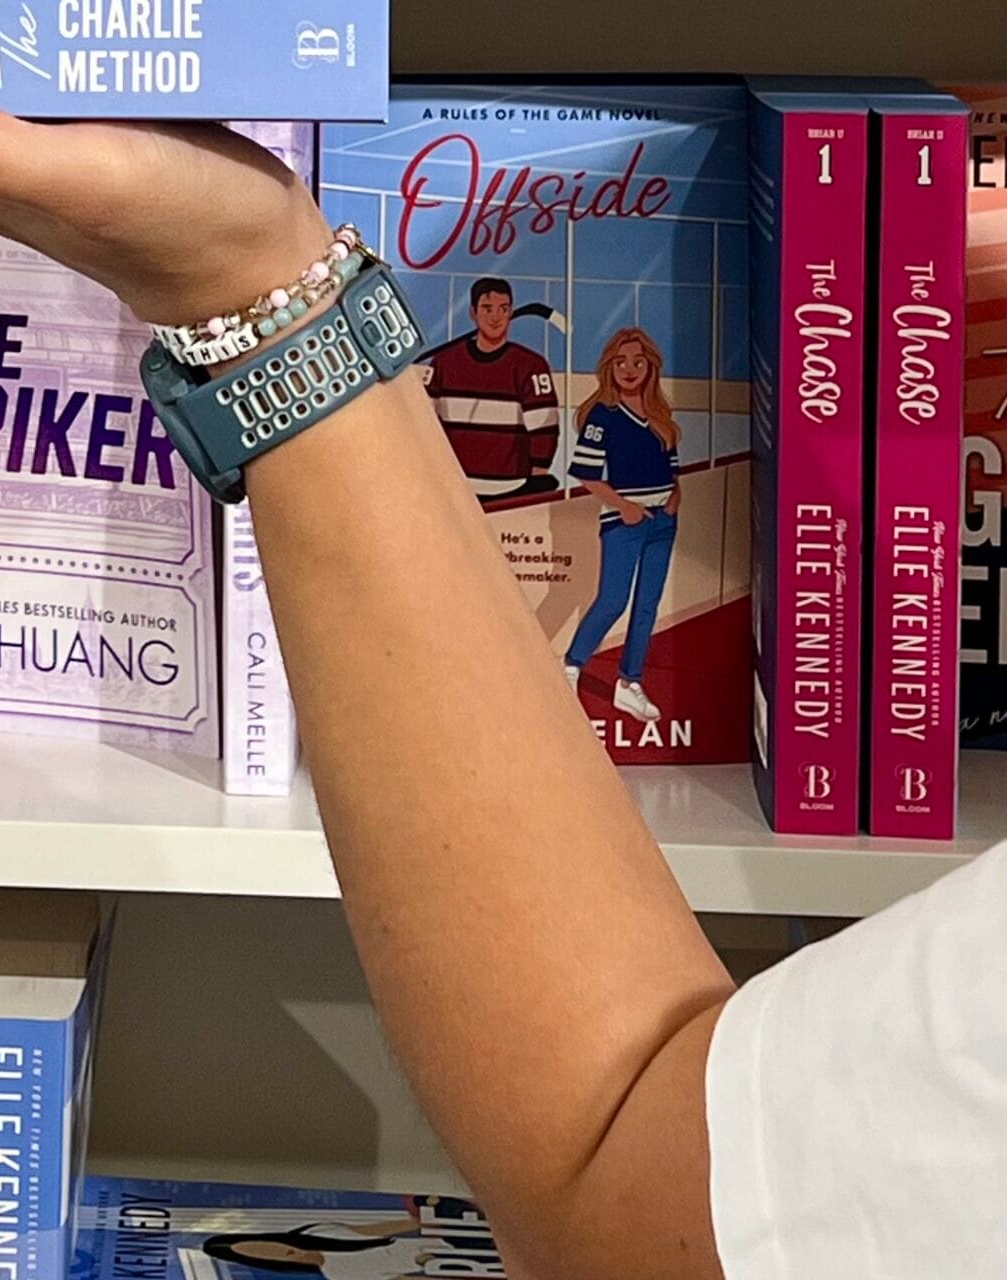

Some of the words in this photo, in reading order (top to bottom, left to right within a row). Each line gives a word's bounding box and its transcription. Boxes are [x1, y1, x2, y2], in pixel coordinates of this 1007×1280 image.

[58, 49, 201, 94] METHOD
[422, 107, 433, 119] A
[440, 107, 488, 120] RULES
[494, 107, 517, 120] OF
[522, 108, 551, 120] THE
[556, 108, 602, 121] GAME
[609, 108, 661, 121] NOVEL
[398, 133, 670, 270] Offside
[806, 260, 837, 300] The
[904, 261, 935, 301] The
[186, 335, 251, 363] THIS
[794, 303, 853, 423] Chase
[893, 304, 951, 425] Chase
[531, 373, 554, 395] 19
[584, 423, 603, 443] 86
[501, 532, 529, 545] He's
[535, 535, 543, 545] a
[796, 504, 832, 576] ELLE
[894, 505, 930, 578] ELLE
[23, 602, 115, 625] BESTSELLING
[120, 613, 177, 632] AUTHOR
[247, 632, 266, 689] CALI
[794, 591, 831, 738] KENNEDY
[891, 593, 928, 741] KENNEDY
[247, 700, 266, 777] MELLE
